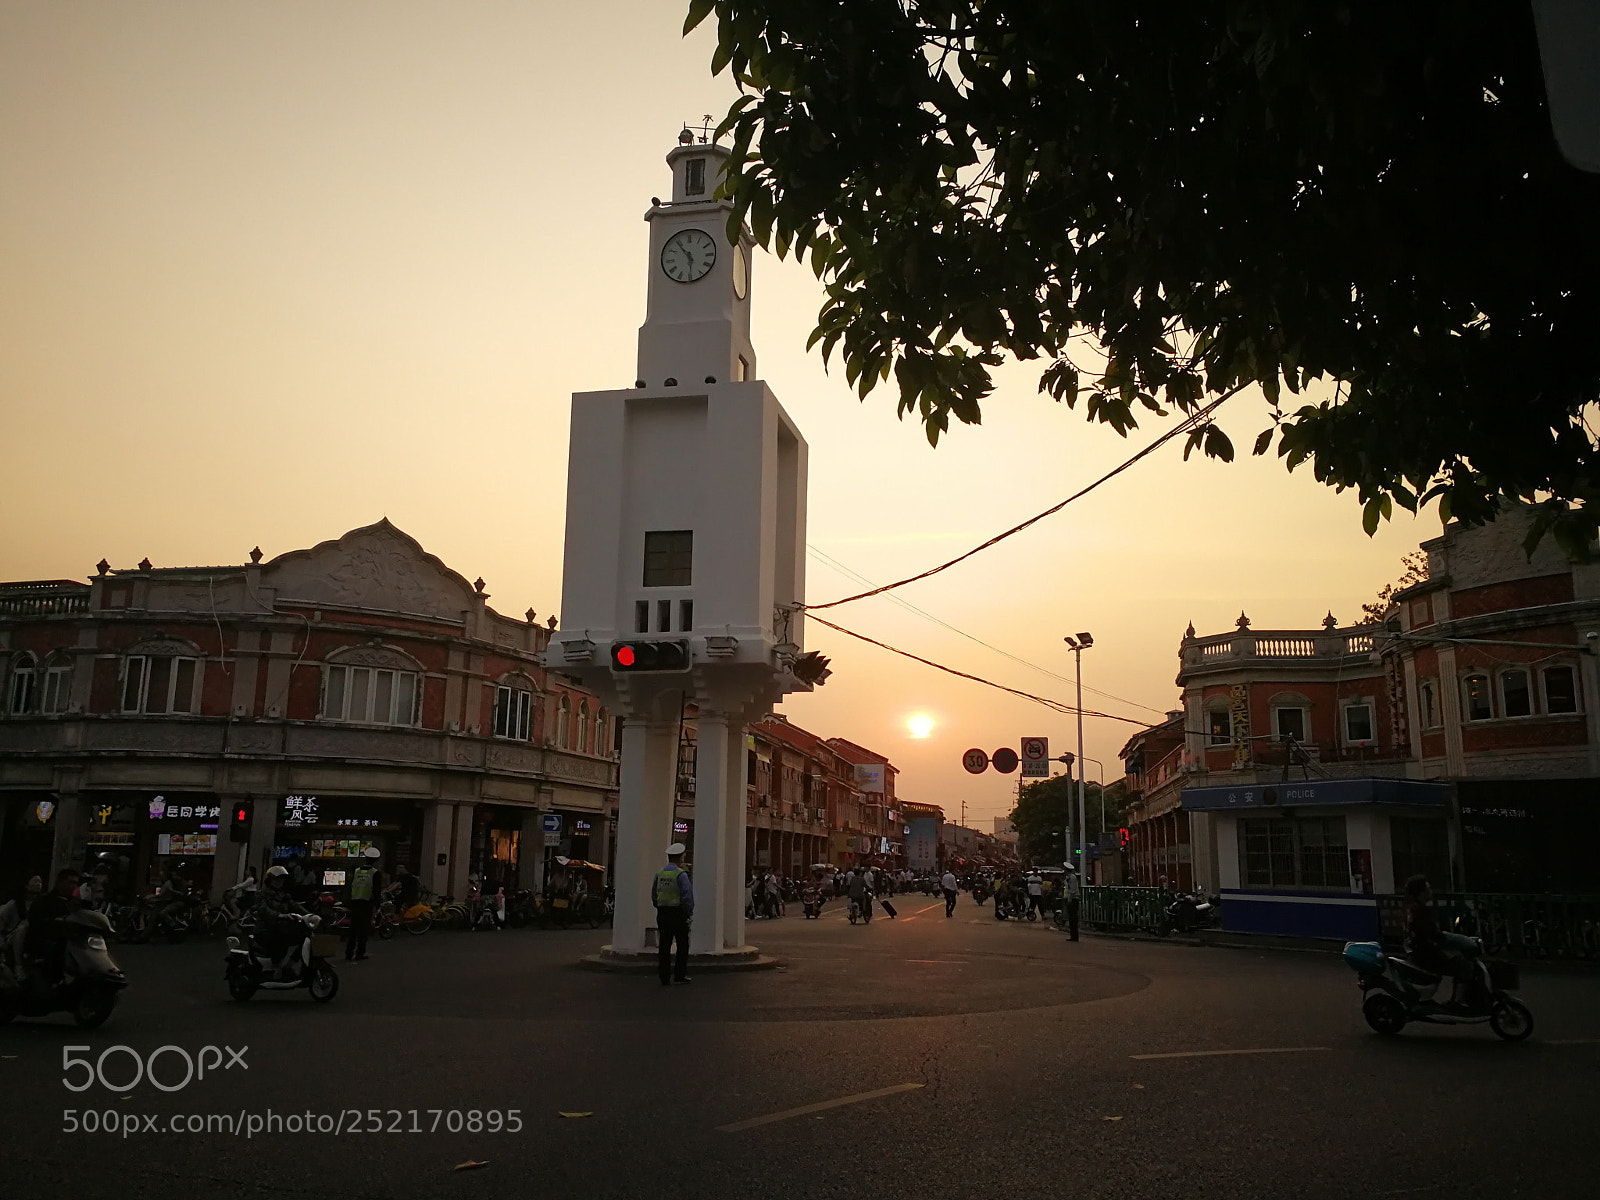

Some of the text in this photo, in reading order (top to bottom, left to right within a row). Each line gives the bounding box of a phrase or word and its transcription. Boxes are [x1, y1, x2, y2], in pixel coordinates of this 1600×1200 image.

[968, 755, 983, 768] 30
[1228, 791, 1254, 803] 公安
[1286, 789, 1315, 799] POLICE
